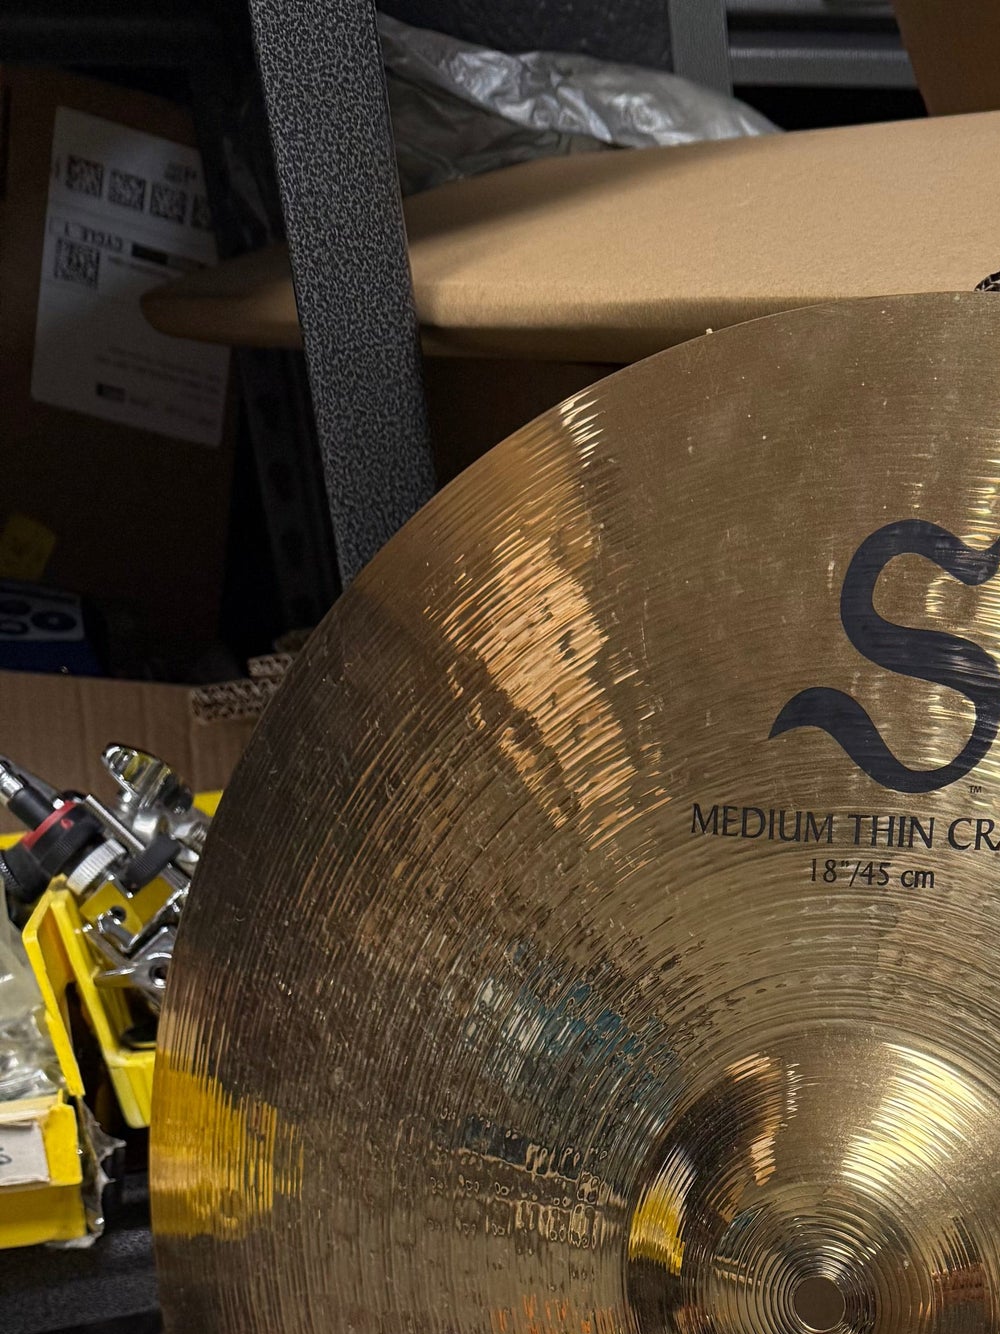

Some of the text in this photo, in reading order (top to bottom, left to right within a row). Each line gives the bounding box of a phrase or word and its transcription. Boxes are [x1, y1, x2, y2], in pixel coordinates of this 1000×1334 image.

[691, 803, 833, 844] MEDIUM
[848, 813, 934, 848] THIN
[901, 866, 935, 888] cm
